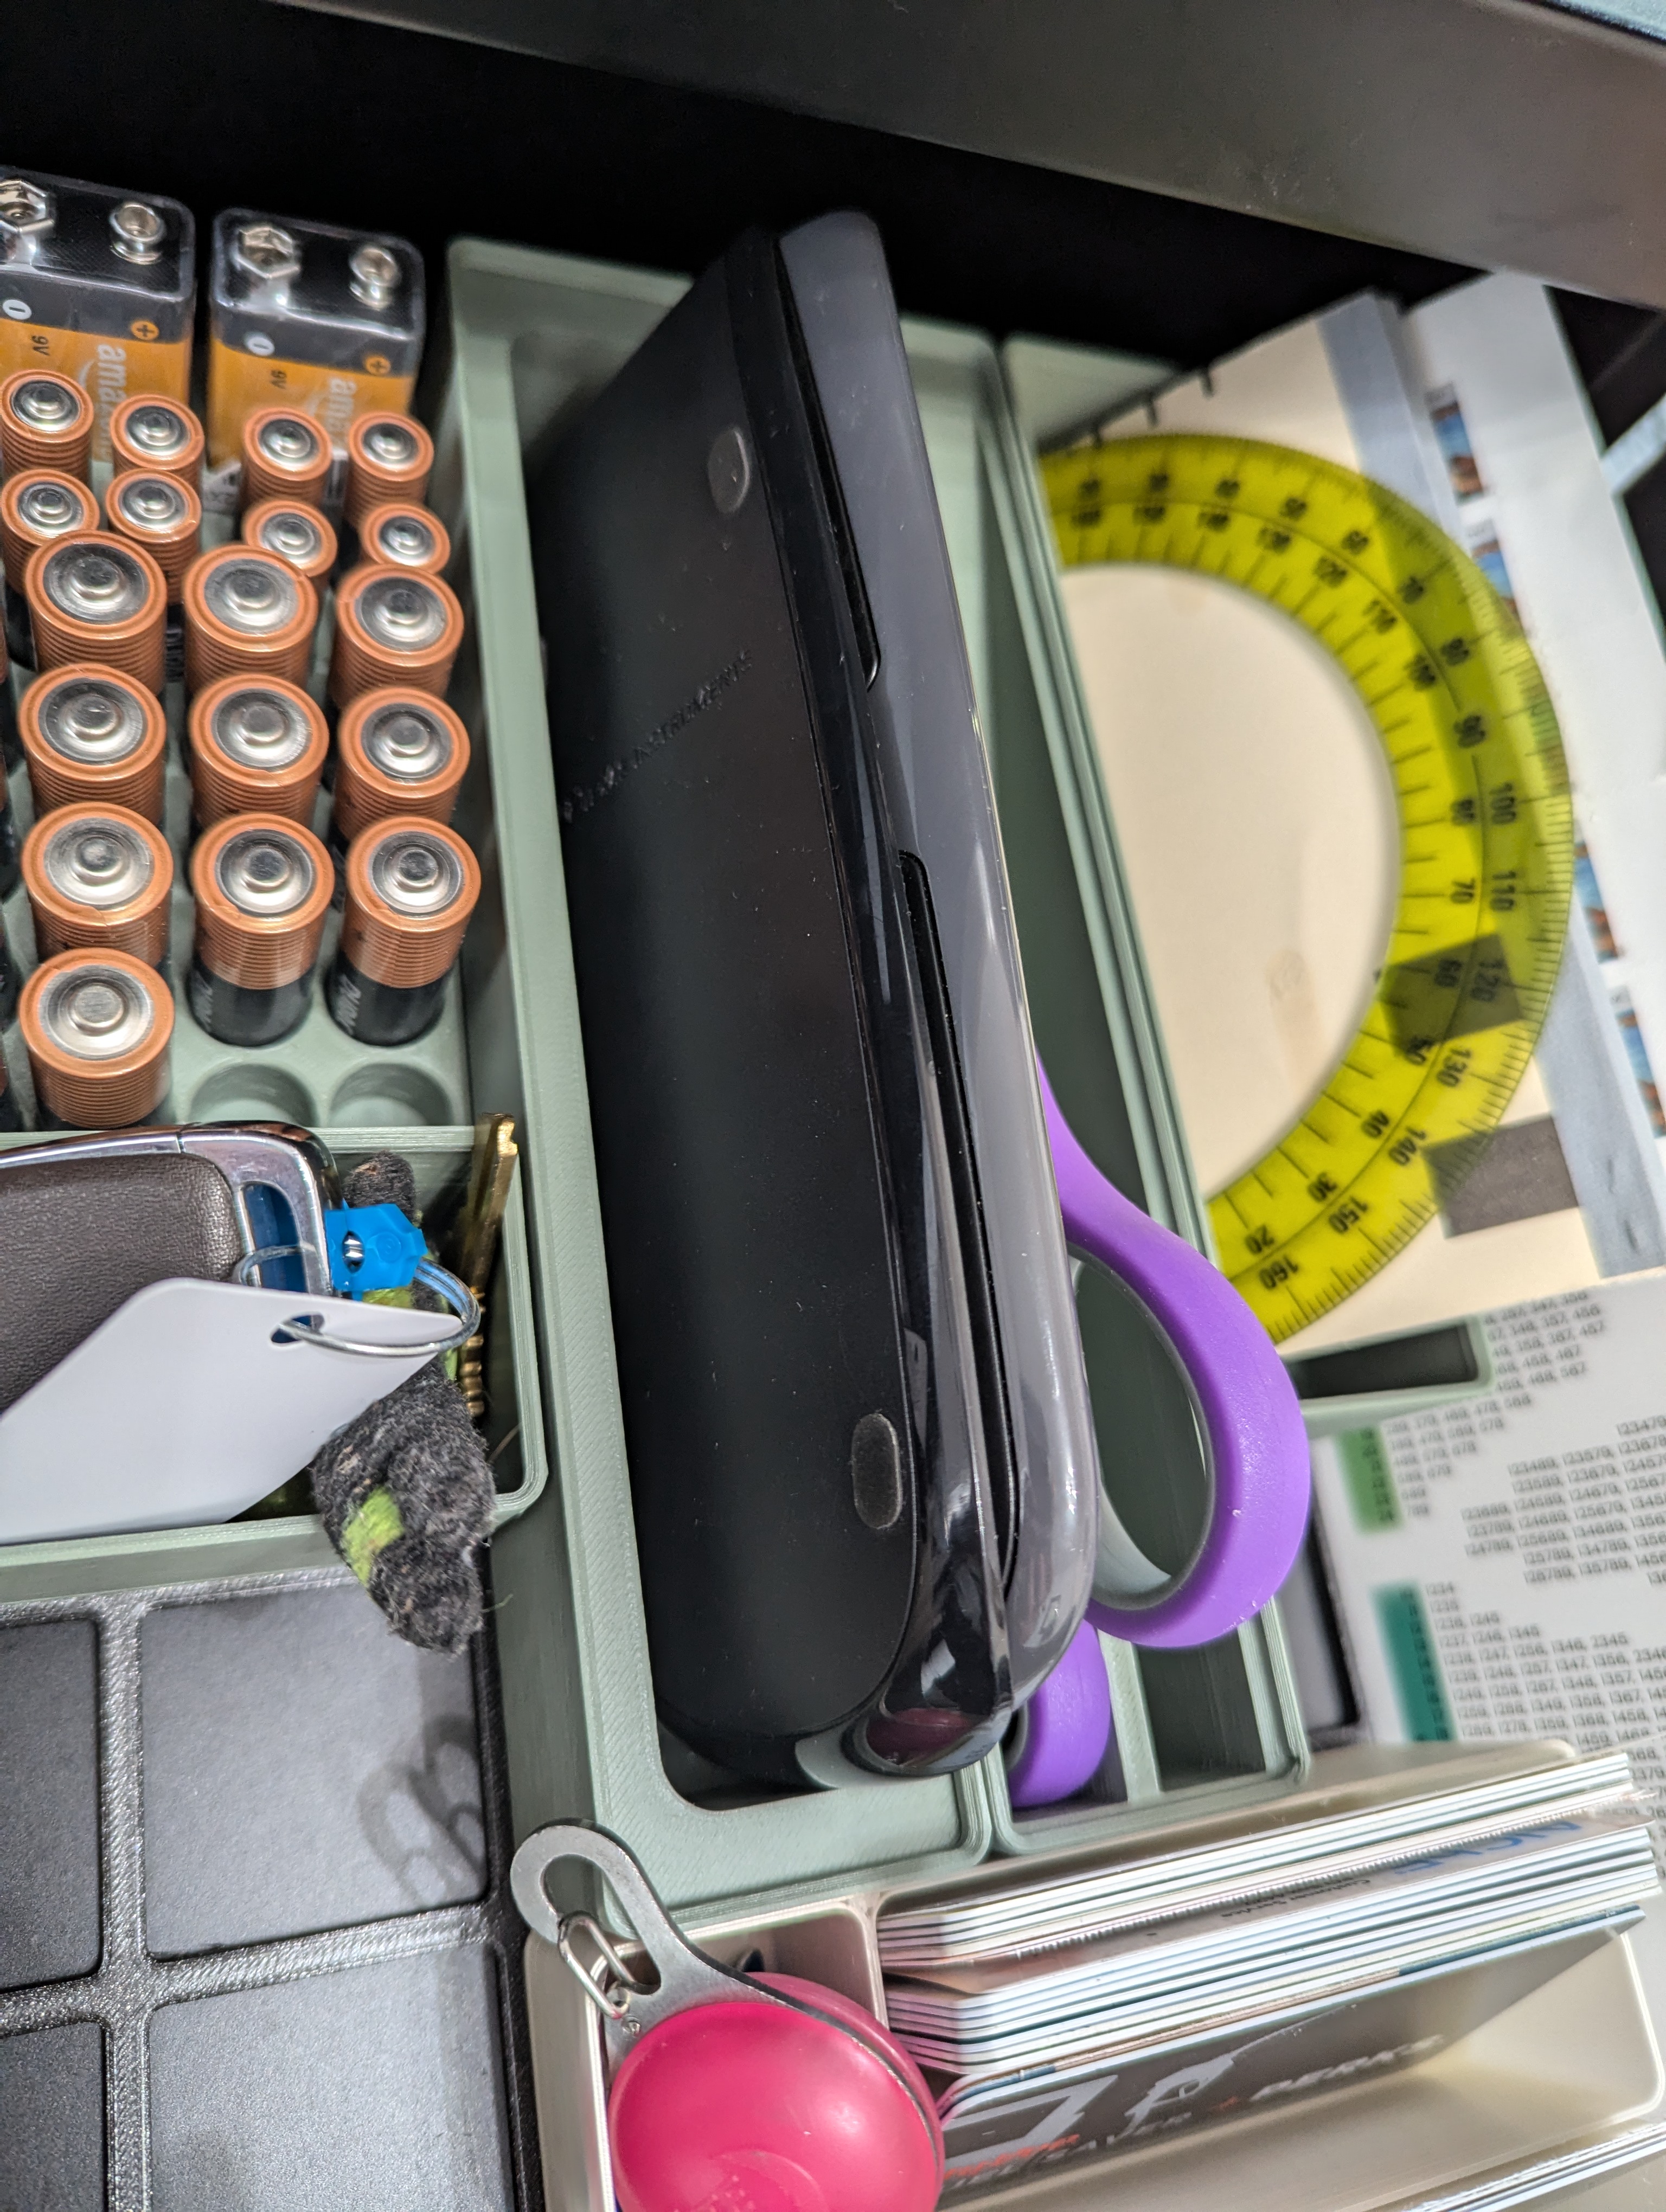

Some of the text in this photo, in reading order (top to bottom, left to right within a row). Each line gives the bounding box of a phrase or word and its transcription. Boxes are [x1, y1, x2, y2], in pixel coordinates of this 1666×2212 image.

[30, 335, 50, 356] 9V
[270, 369, 288, 389] 9V
[1489, 781, 1517, 825] 100
[1451, 877, 1477, 904] 70
[1490, 870, 1517, 911] 110
[1434, 958, 1463, 988] 60
[1470, 960, 1503, 1004] 120
[1406, 1034, 1437, 1066] 50
[1437, 1046, 1471, 1088] 130
[1360, 1109, 1392, 1140] 40
[1388, 1124, 1427, 1167] 140
[1306, 1171, 1339, 1203] 30
[1328, 1194, 1369, 1234] 150
[1245, 1224, 1276, 1255] 20
[1258, 1254, 1299, 1290] 160
